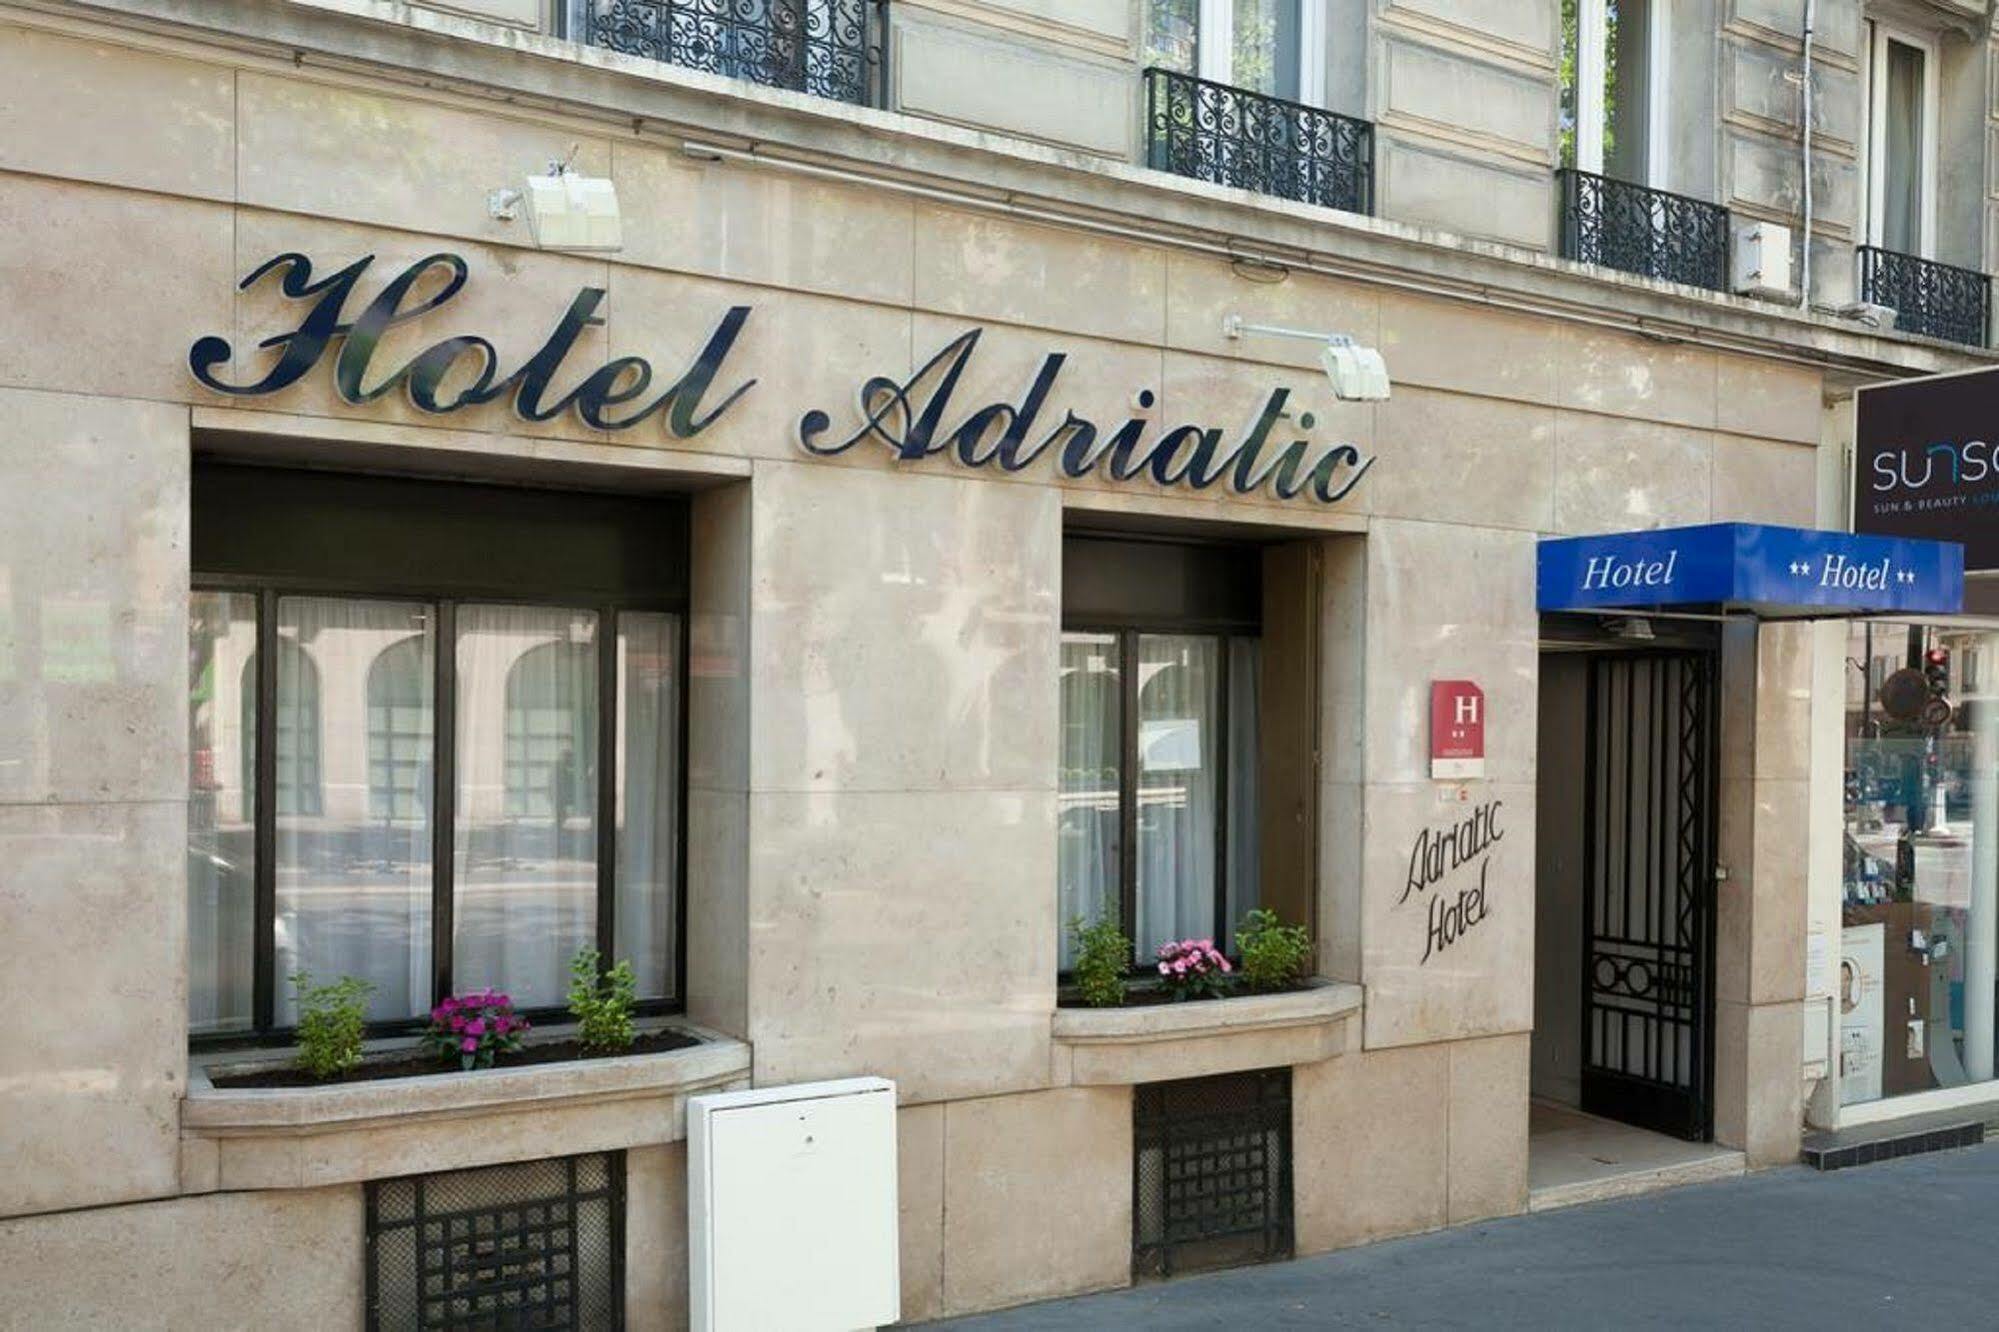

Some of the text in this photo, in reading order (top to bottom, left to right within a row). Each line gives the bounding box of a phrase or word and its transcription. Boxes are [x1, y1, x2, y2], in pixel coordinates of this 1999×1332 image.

[189, 253, 1375, 501] Hotel Adriatic
[1873, 501, 1899, 514] SUN
[1918, 495, 1967, 511] BEAUTY
[1582, 550, 1678, 590] Hotel
[1820, 554, 1891, 590] Hotel
[1455, 695, 1478, 724] H
[1399, 800, 1504, 905] Adriatic
[1420, 855, 1490, 966] Hotel
